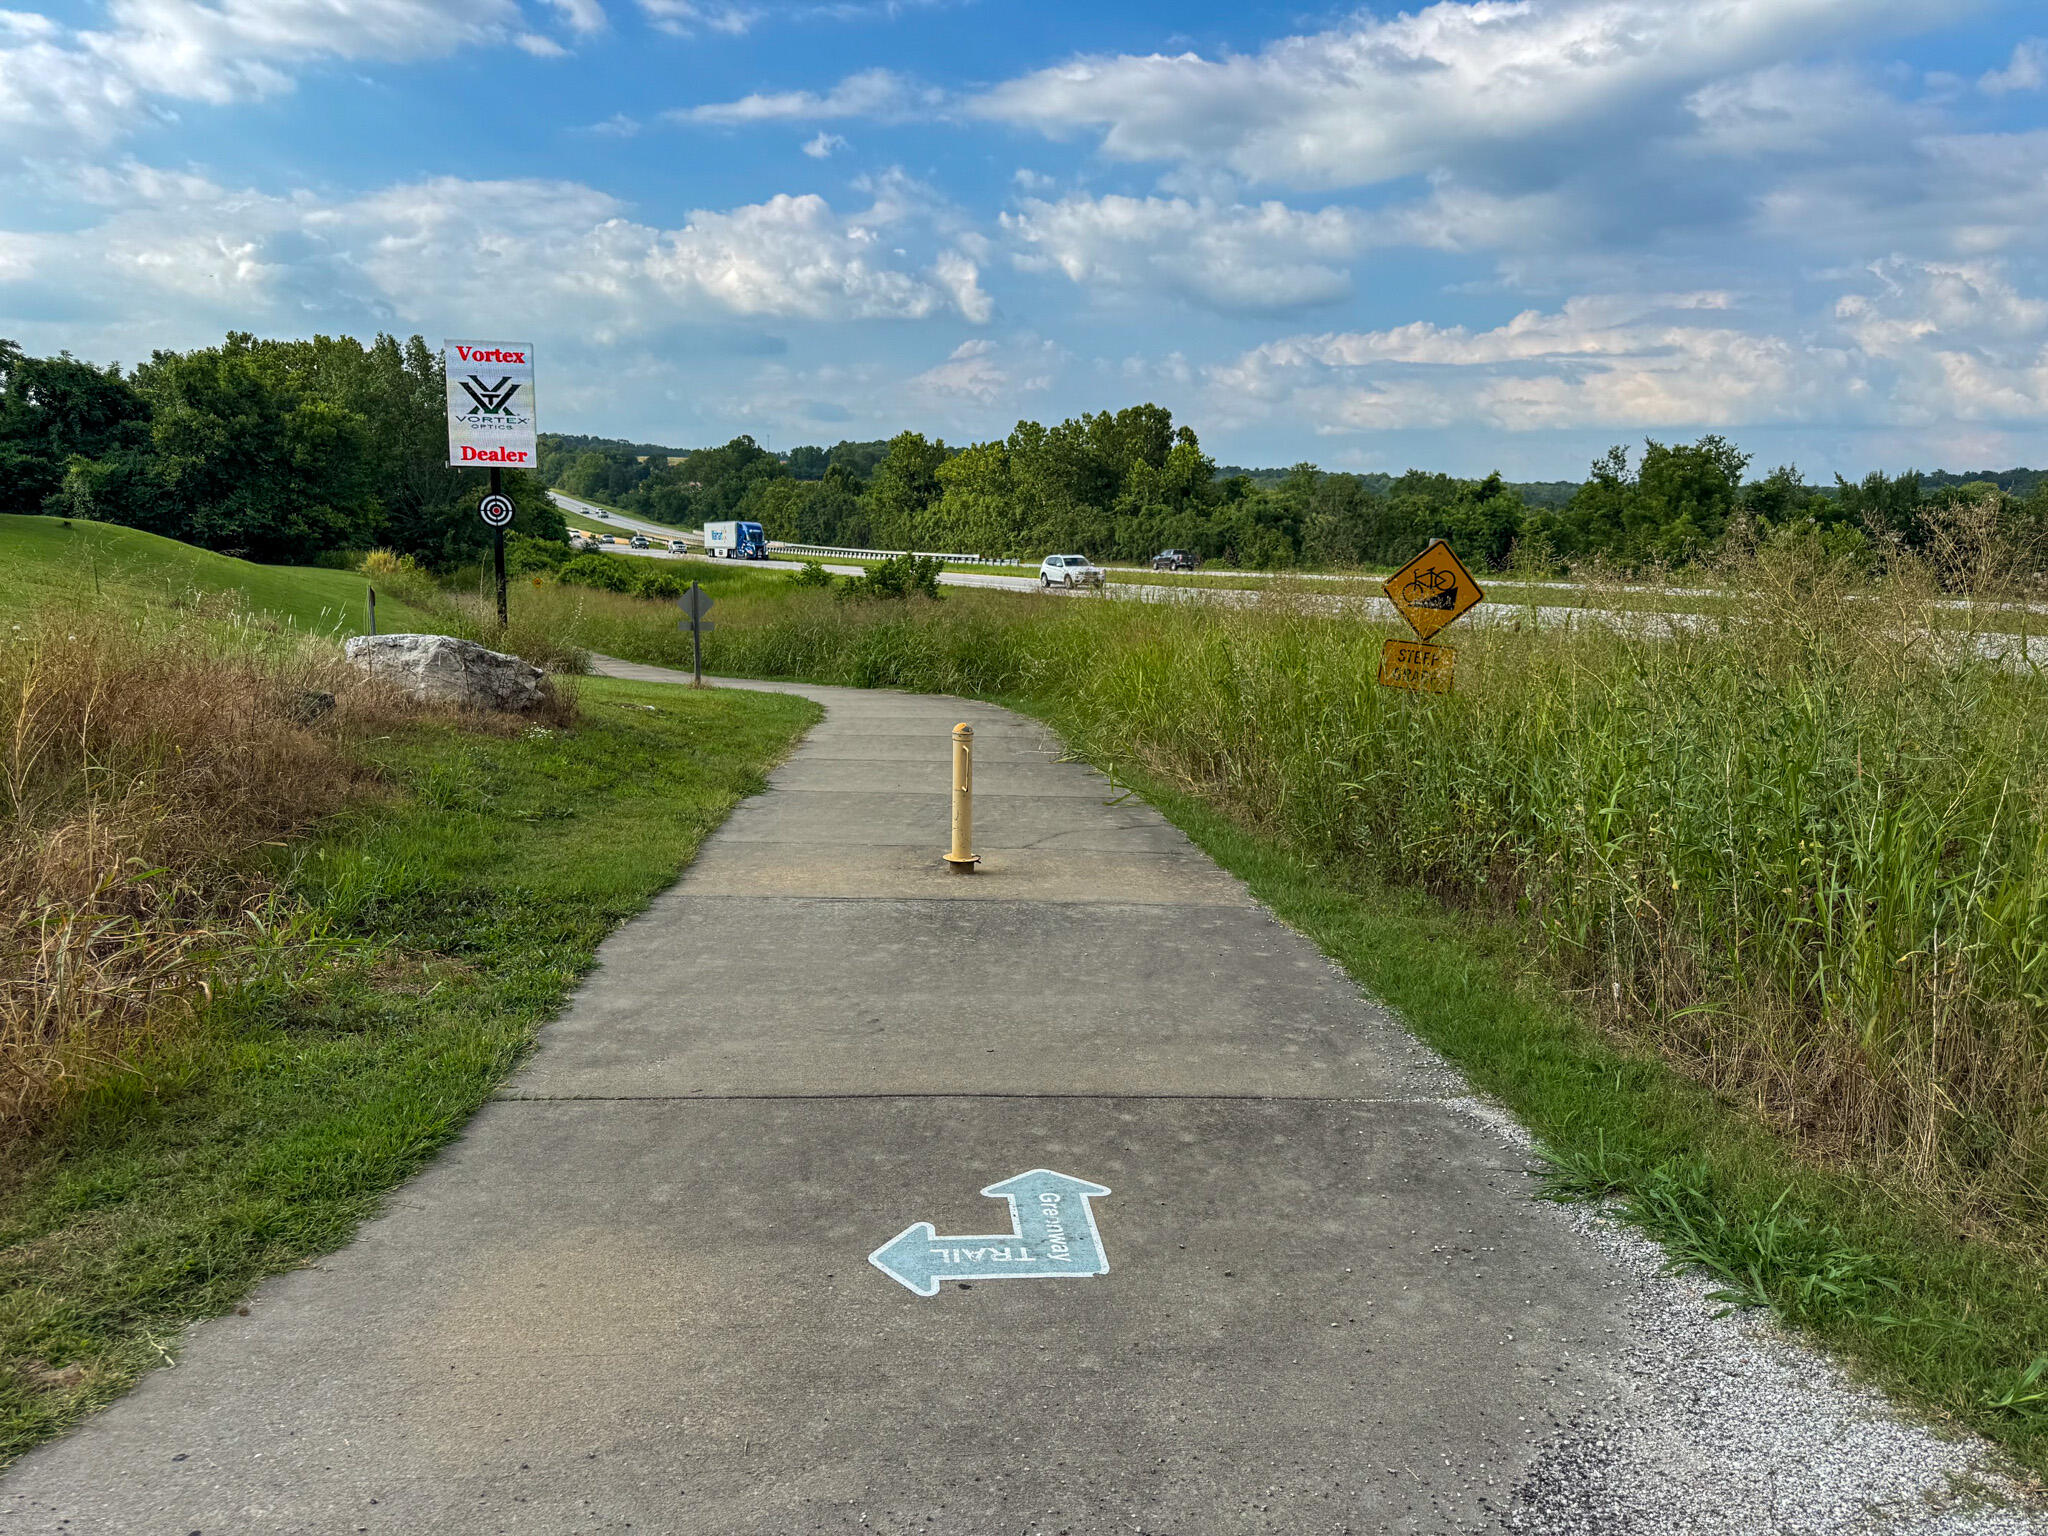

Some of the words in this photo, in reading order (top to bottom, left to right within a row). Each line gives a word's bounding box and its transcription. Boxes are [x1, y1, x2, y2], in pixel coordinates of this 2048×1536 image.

[456, 345, 526, 364] Vortex
[456, 416, 528, 425] VORTEX
[460, 446, 528, 463] Dealer
[929, 1247, 1036, 1264] TRAIL
